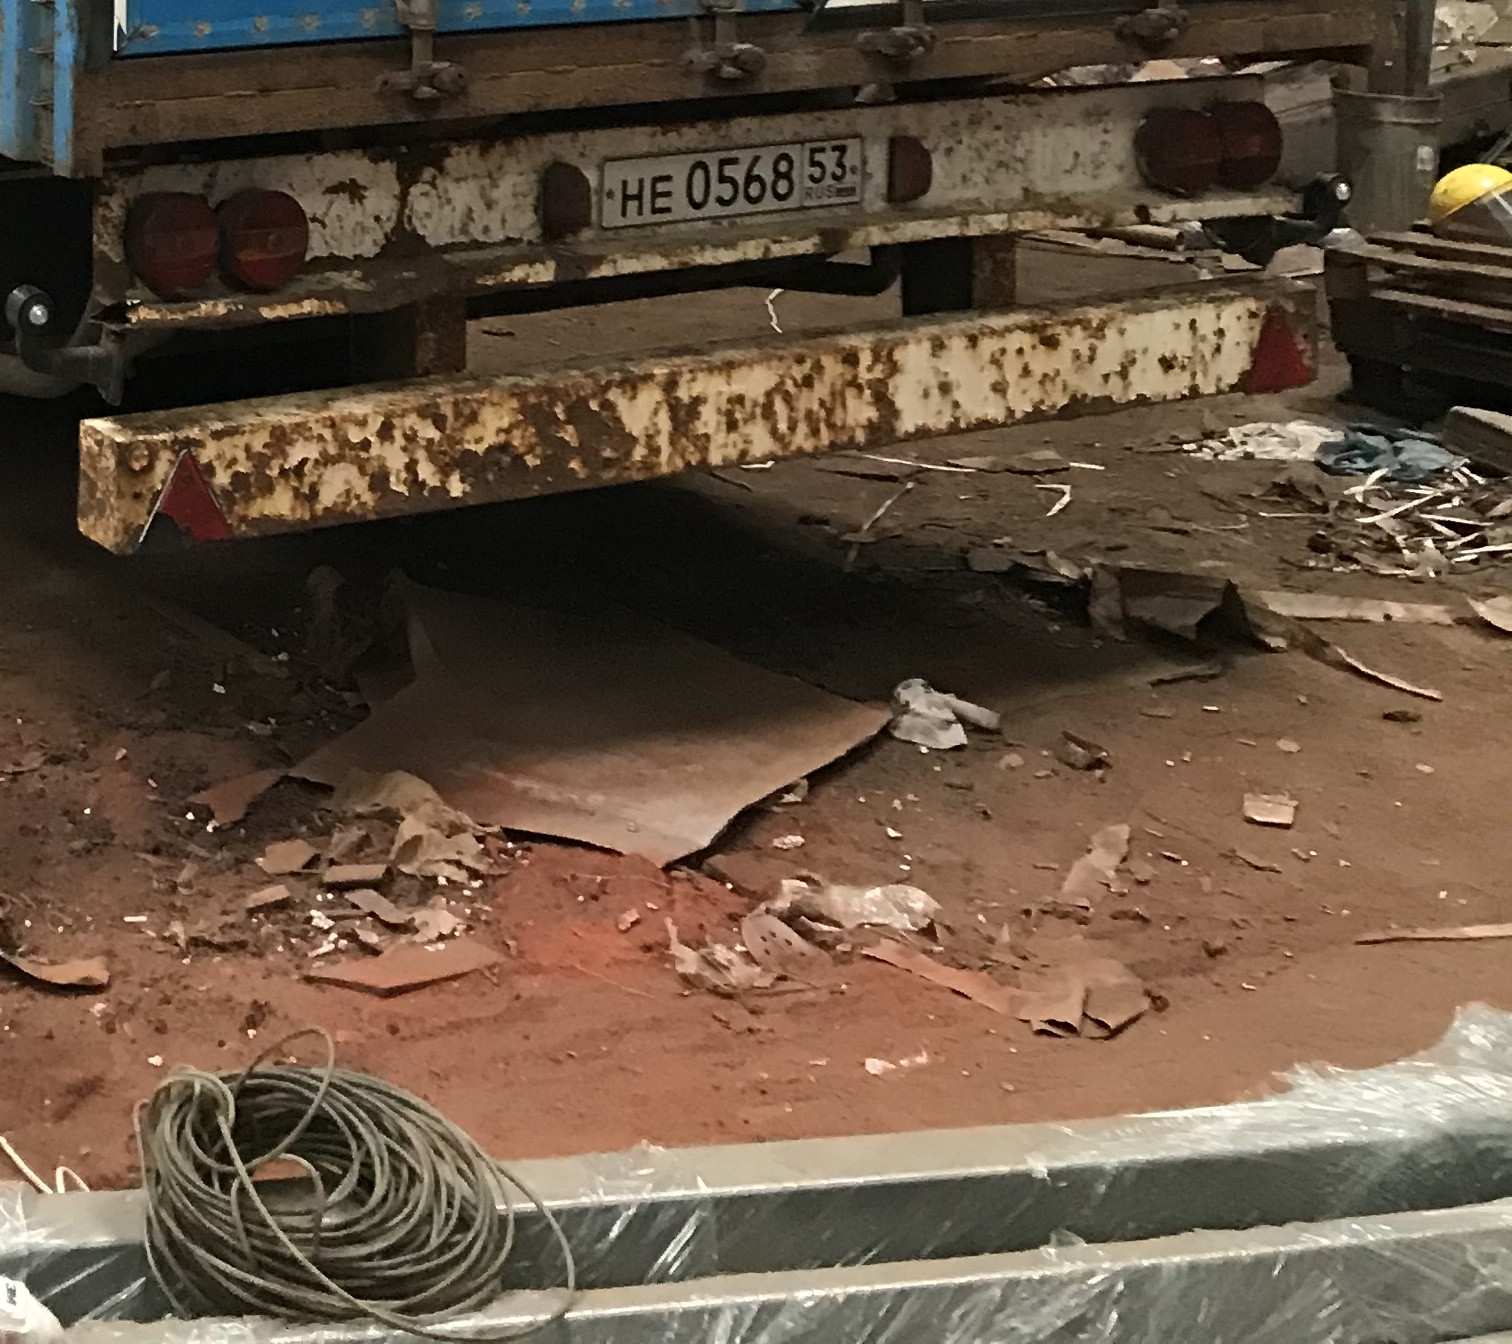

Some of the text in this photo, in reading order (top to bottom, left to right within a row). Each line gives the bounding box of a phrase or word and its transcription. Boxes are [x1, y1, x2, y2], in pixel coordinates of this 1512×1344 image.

[685, 152, 795, 211] 0568
[806, 144, 849, 185] 53
[805, 186, 836, 200] RUS
